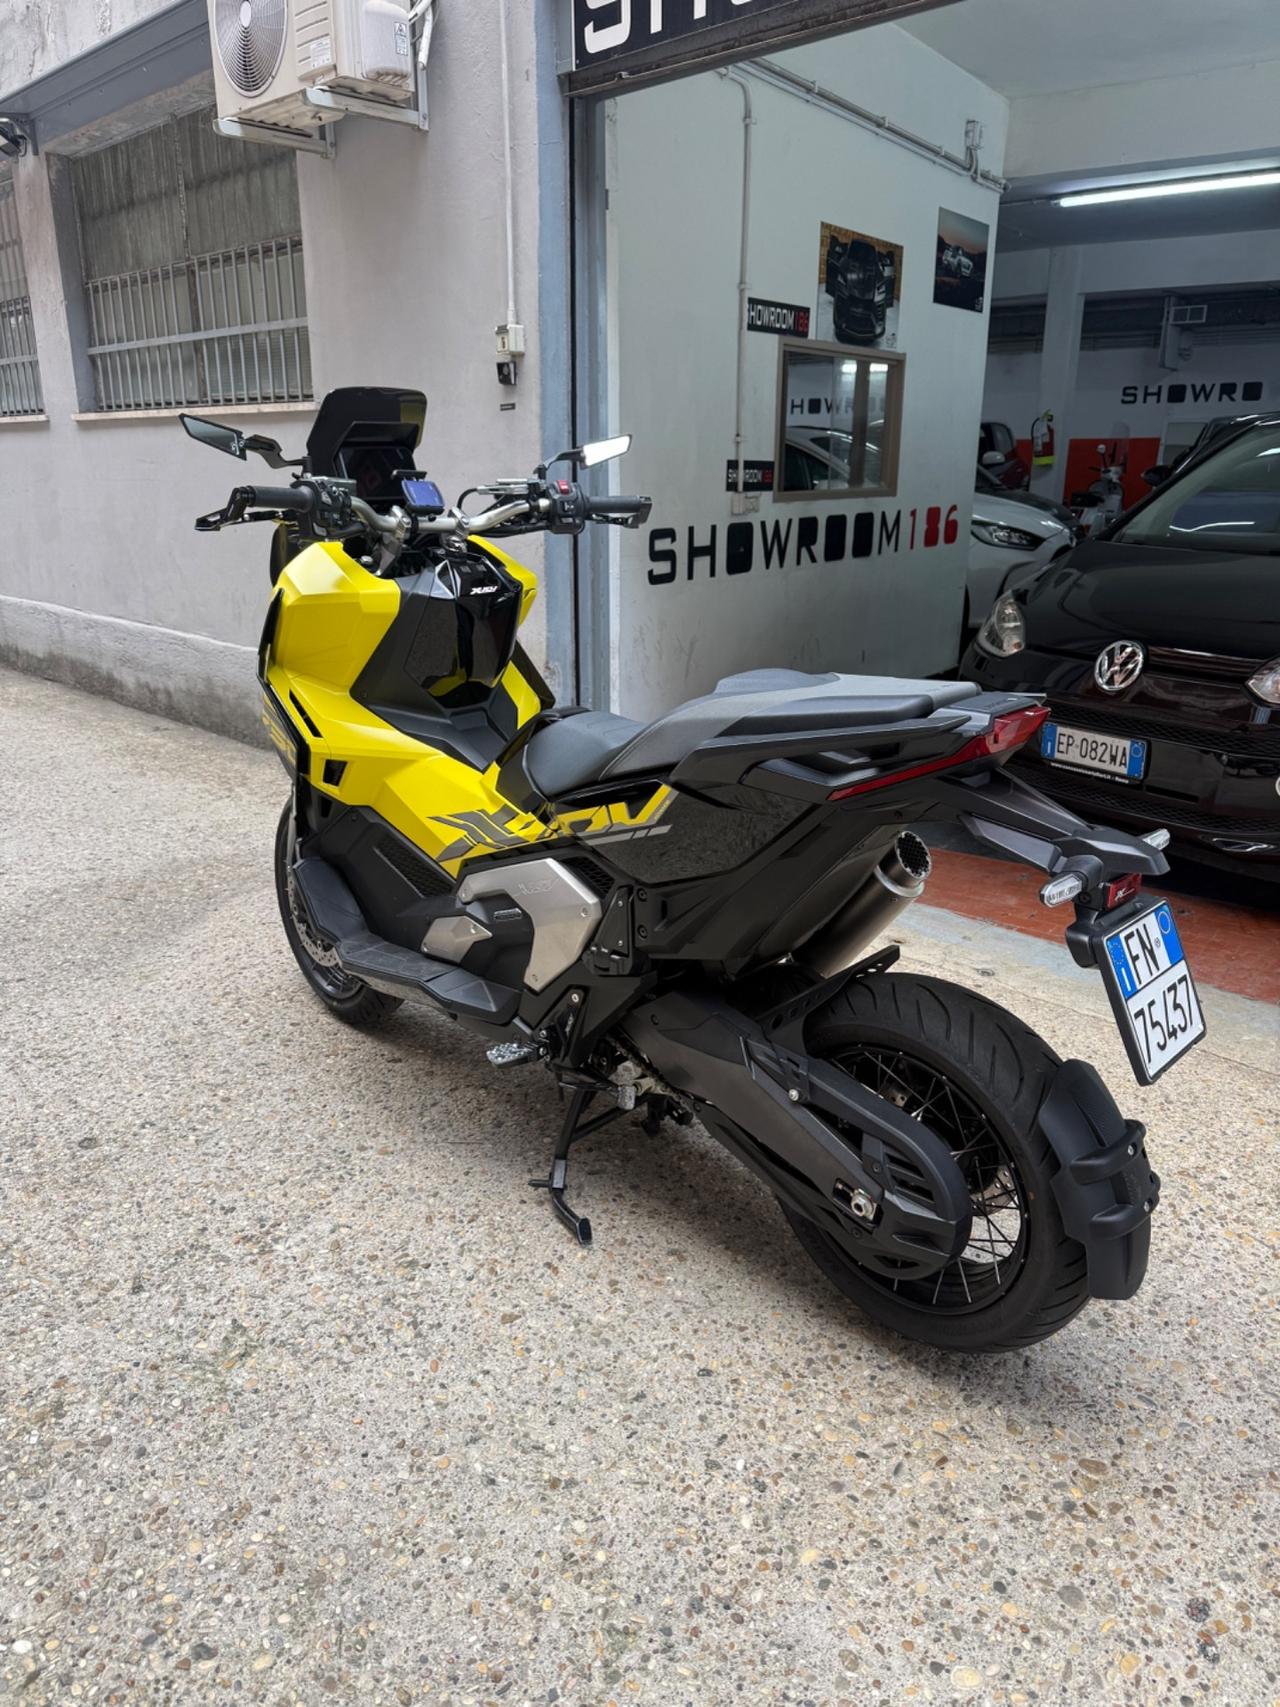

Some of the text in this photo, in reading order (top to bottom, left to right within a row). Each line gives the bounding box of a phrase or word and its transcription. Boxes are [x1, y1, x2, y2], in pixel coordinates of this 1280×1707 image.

[1120, 381, 1264, 405] SHOWRO
[1123, 923, 1160, 985] FN
[1133, 974, 1194, 1063] 75437
